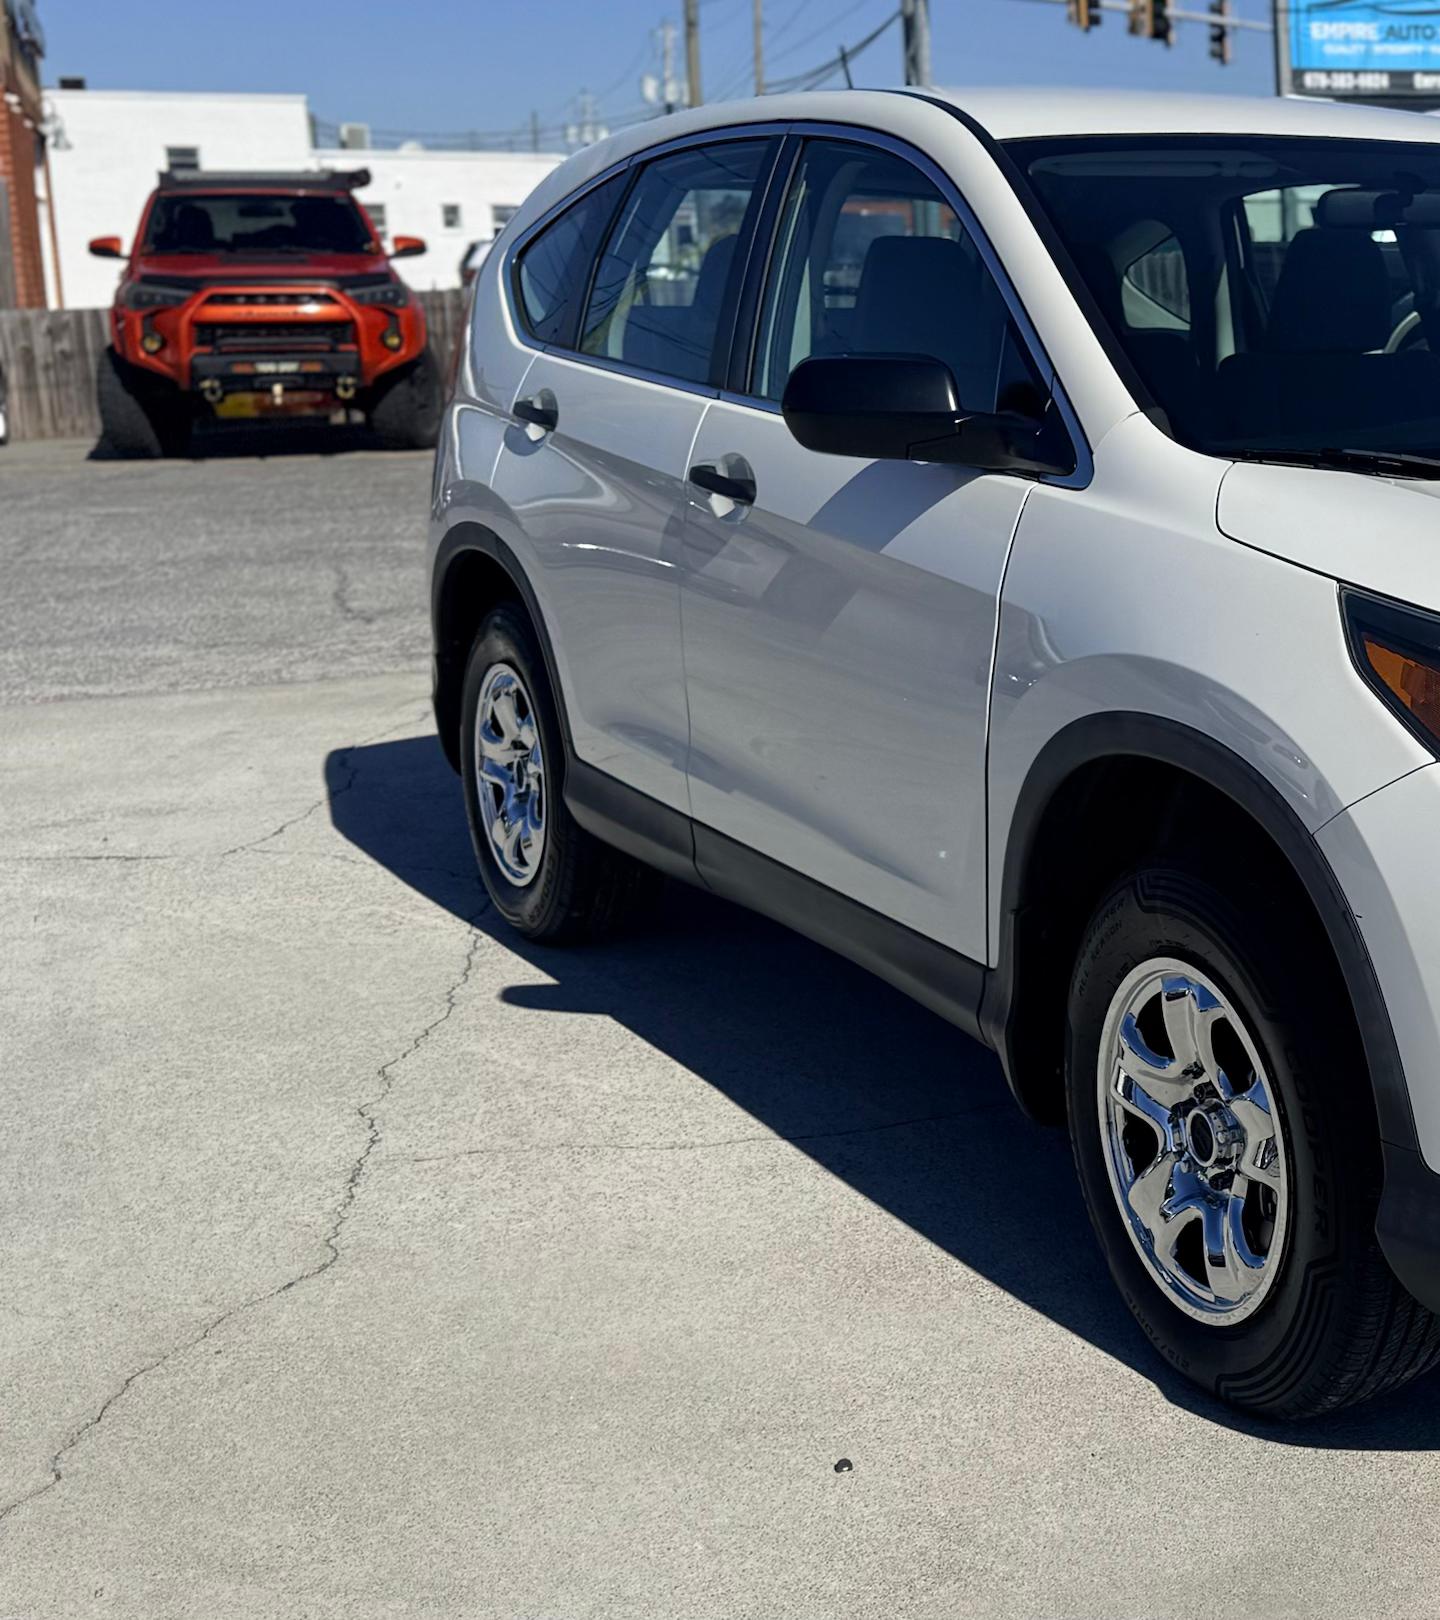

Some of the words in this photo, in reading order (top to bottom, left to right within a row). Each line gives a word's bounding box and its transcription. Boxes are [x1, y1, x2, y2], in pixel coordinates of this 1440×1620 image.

[1310, 22, 1379, 41] EMPIRE
[1384, 24, 1437, 41] AUTO
[1284, 1046, 1330, 1240] COOPER
